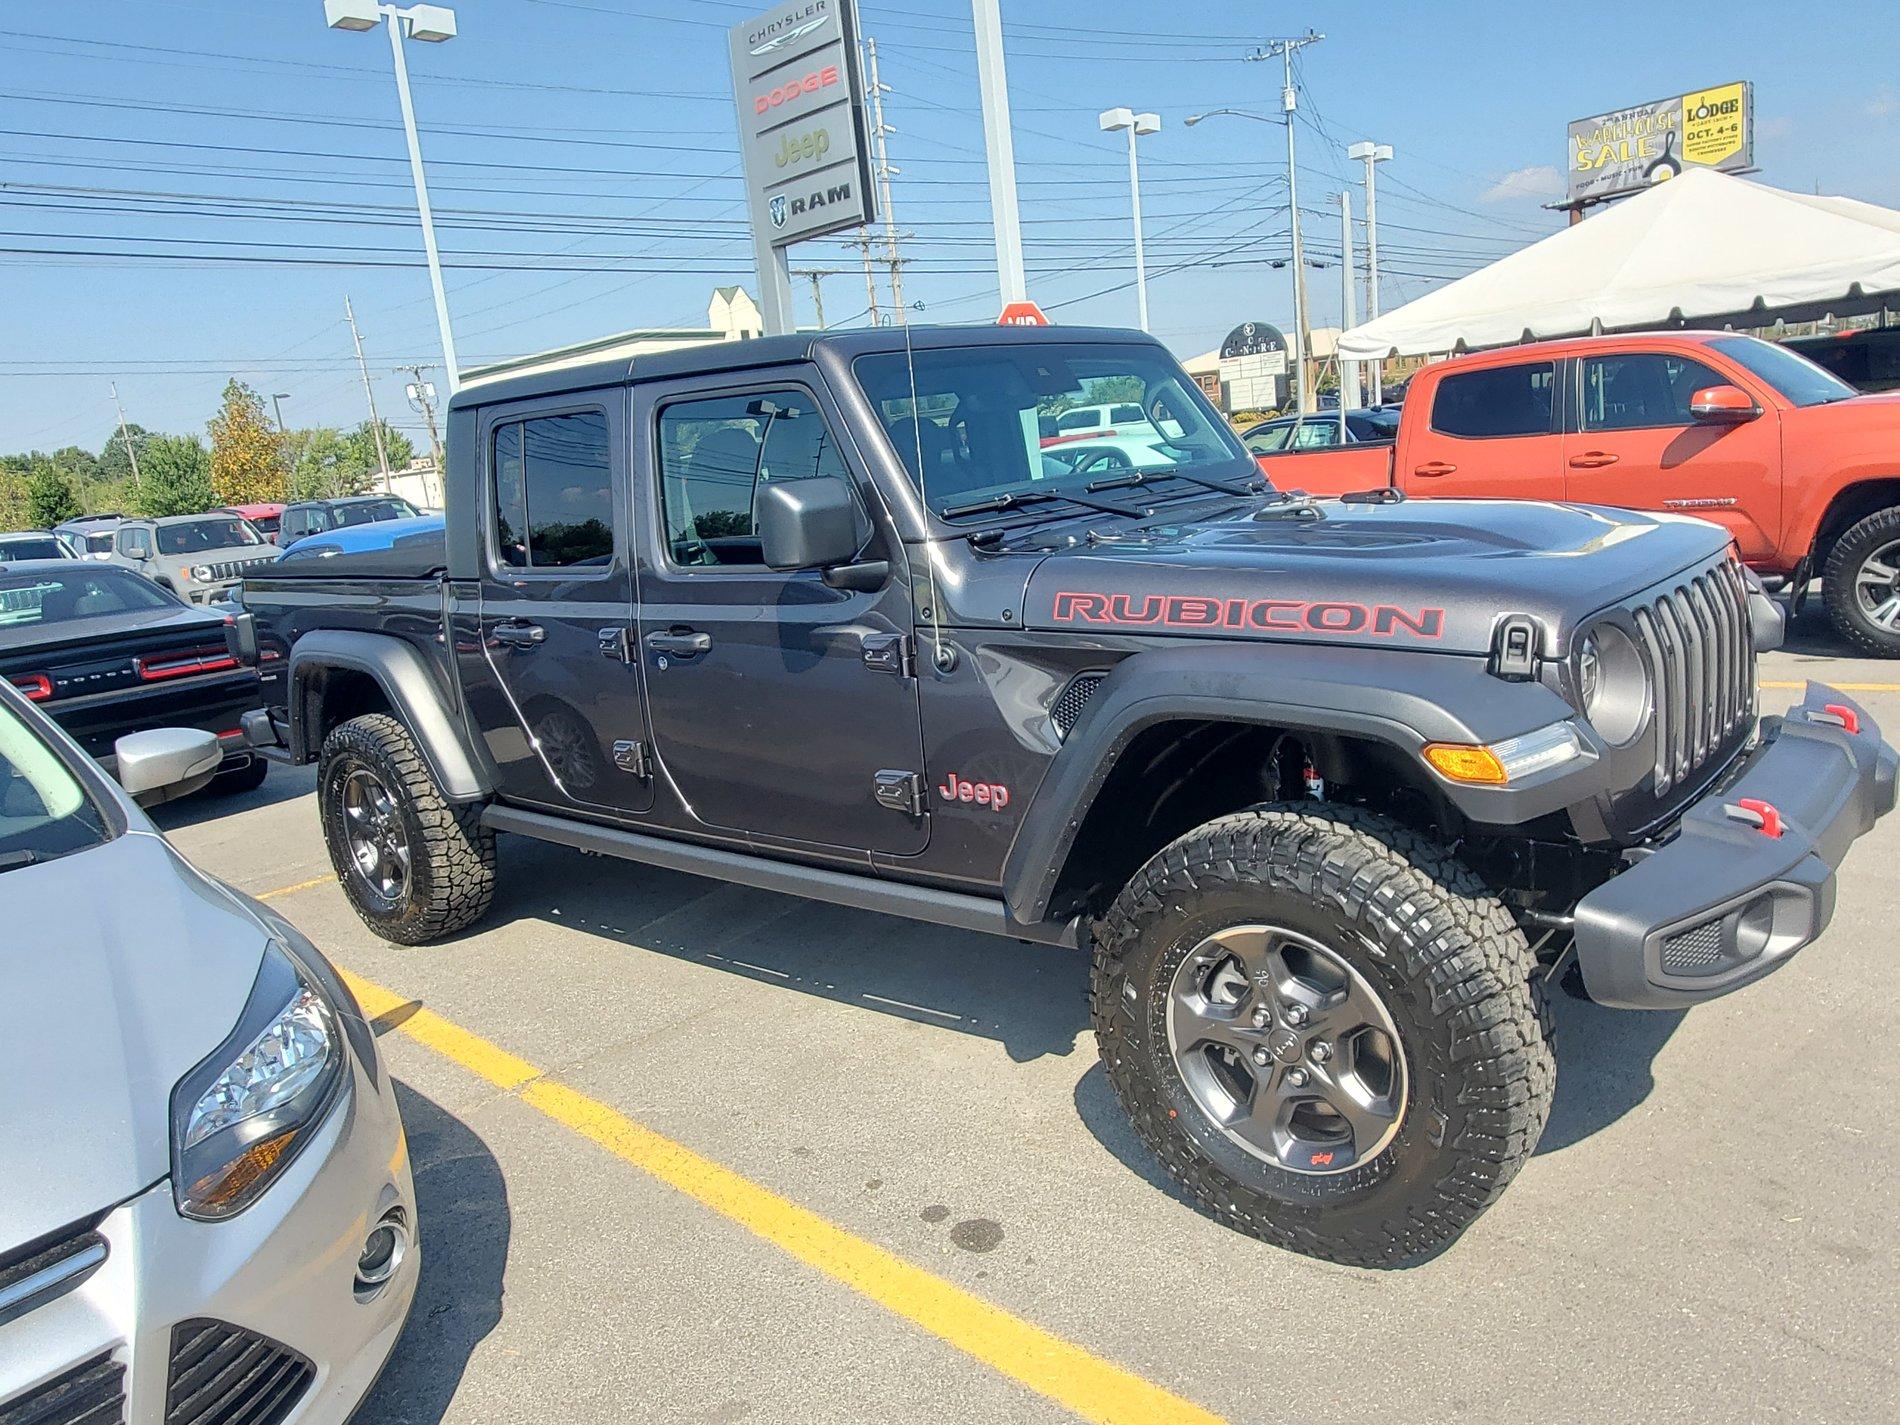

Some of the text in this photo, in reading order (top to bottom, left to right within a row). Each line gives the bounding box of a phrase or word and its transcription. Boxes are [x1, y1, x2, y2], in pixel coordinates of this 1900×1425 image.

[748, 0, 827, 45] CHRYSLER
[754, 64, 839, 115] DODGE
[1687, 98, 1739, 122] LODGE
[774, 127, 830, 168] Jeep
[1575, 111, 1676, 149] WAREHOUSE
[1686, 128, 1714, 141] OCT.
[1717, 123, 1738, 135] 4-6
[1576, 135, 1657, 172] SALE
[790, 182, 851, 216] RAM
[1051, 591, 1445, 640] RUBICON
[938, 772, 1009, 812] Jeep
